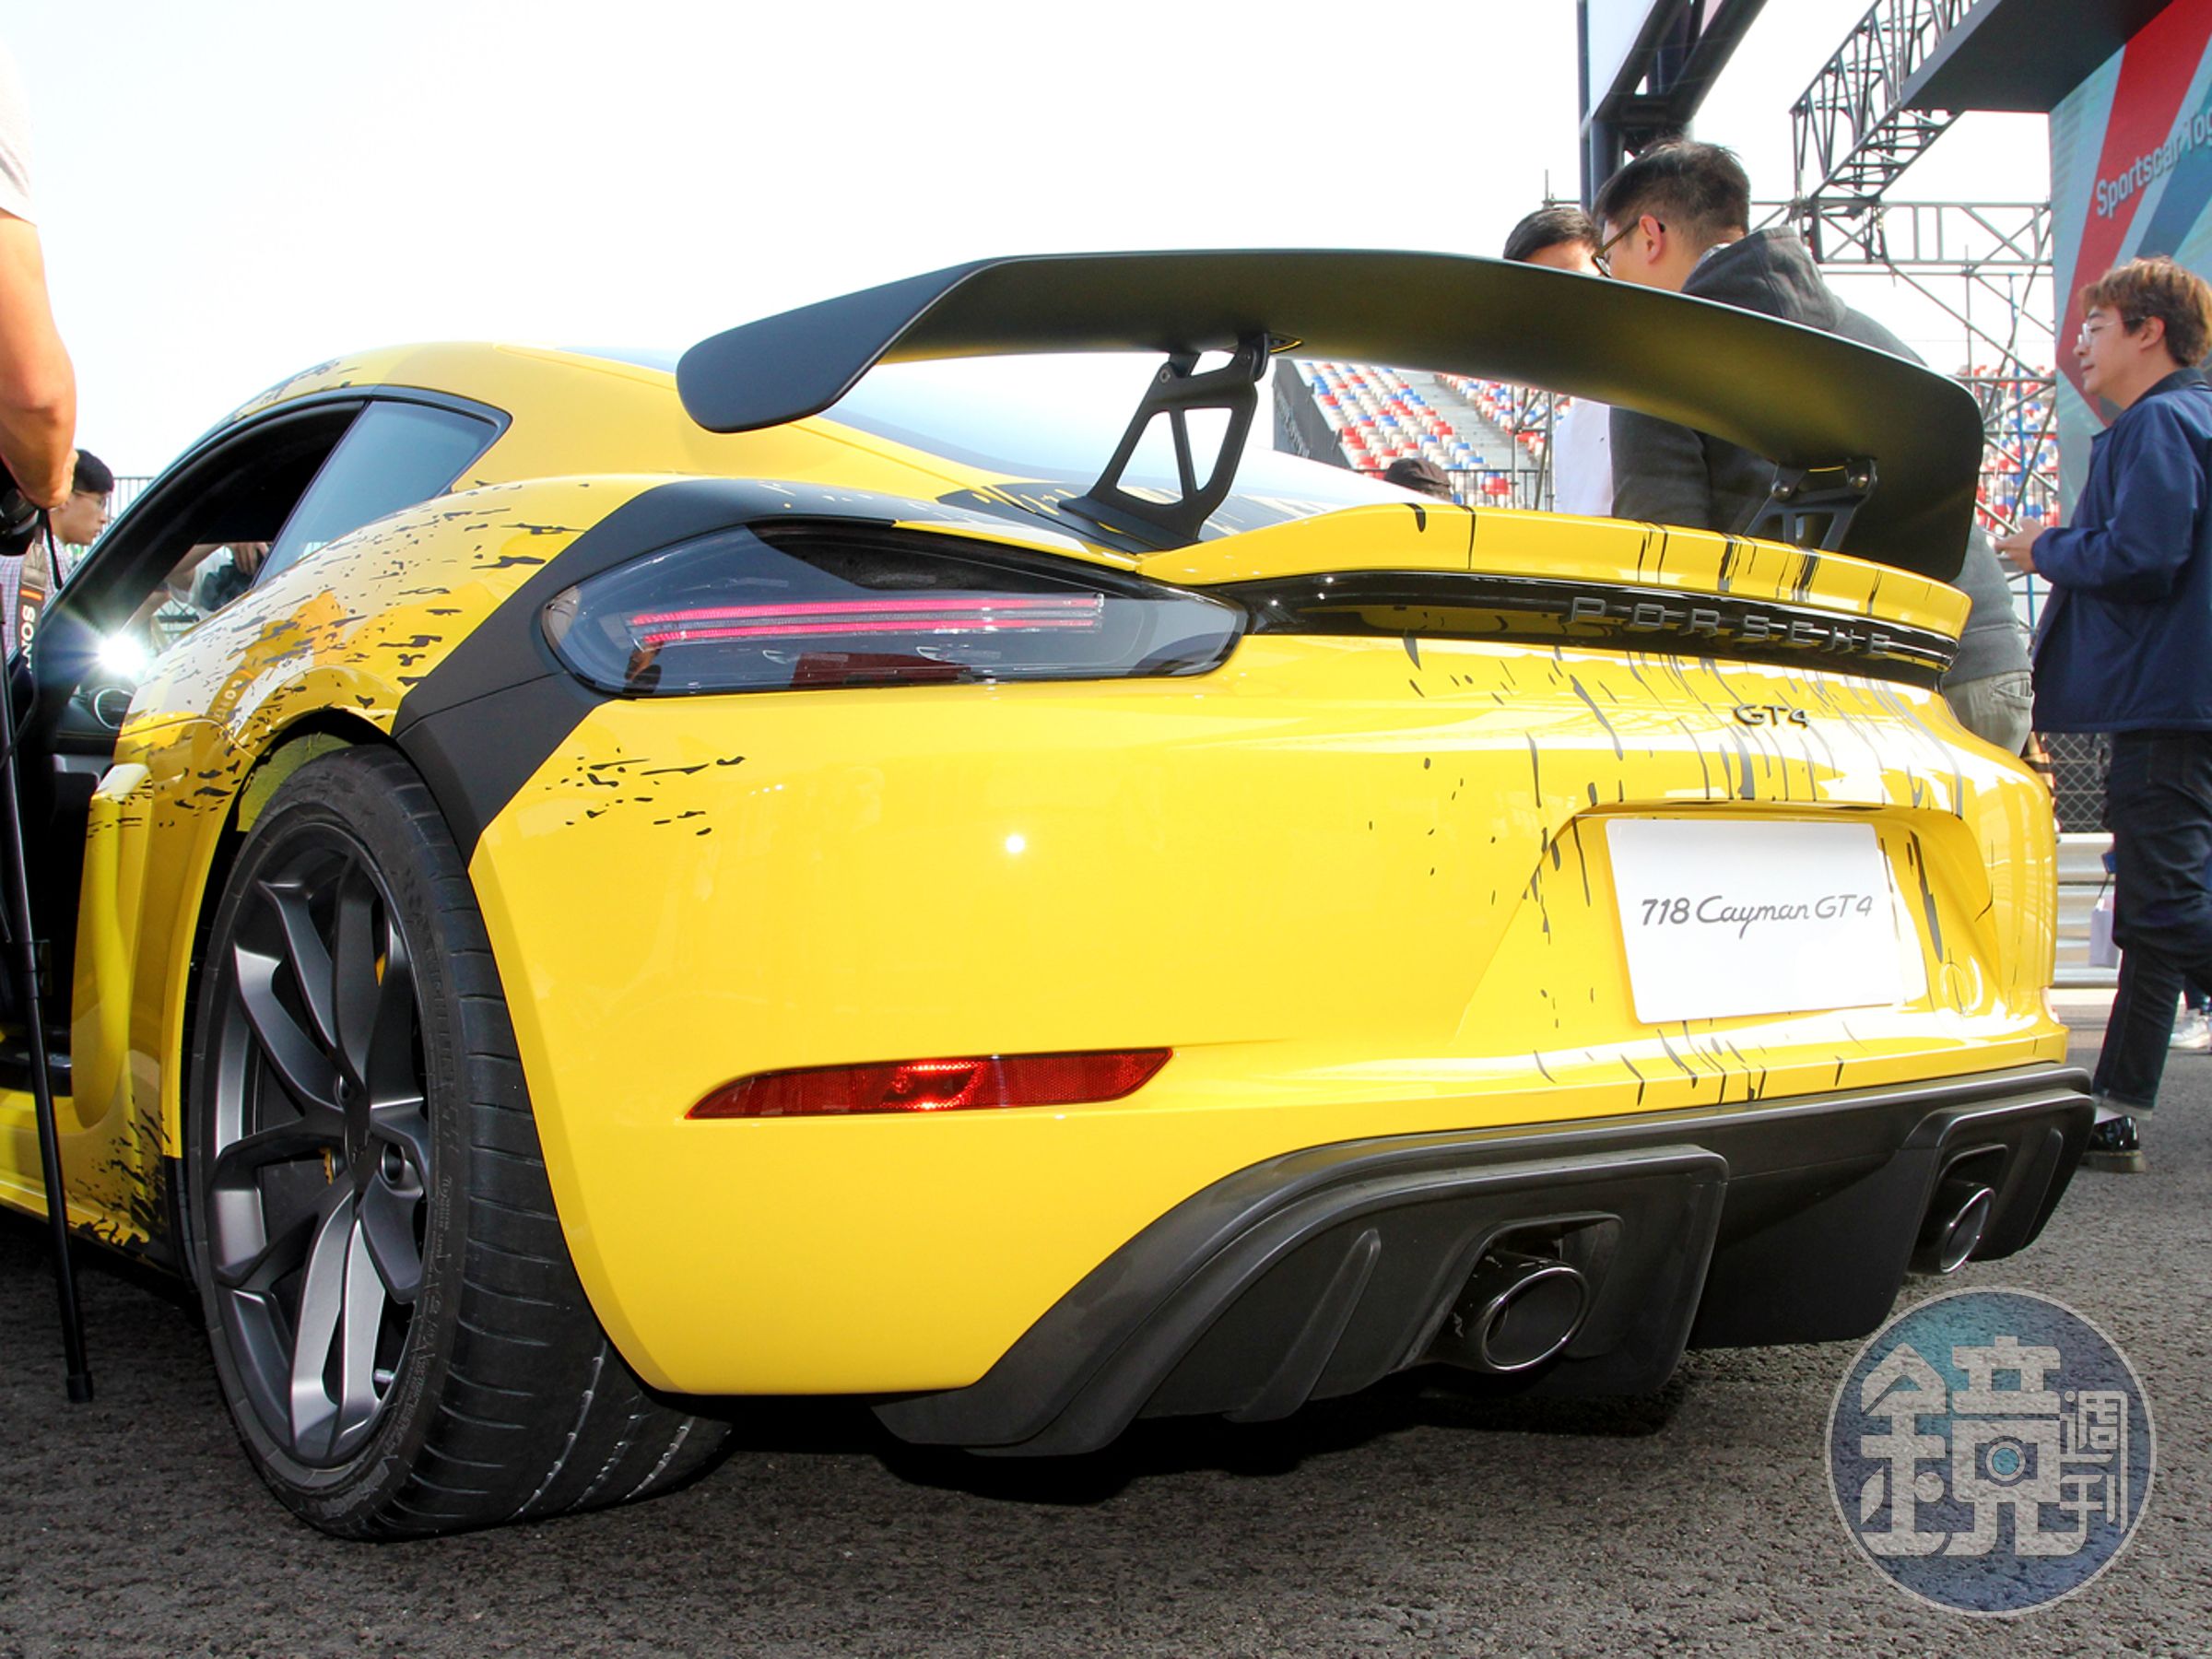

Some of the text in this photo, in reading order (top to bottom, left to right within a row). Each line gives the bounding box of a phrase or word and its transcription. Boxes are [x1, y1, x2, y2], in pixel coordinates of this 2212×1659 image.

[2097, 135, 2185, 218] Sportscar
[1571, 596, 1890, 655] PORSCHE
[1734, 703, 1810, 728] GT4
[1641, 897, 1690, 926] 718
[1696, 895, 1810, 939] Cayman
